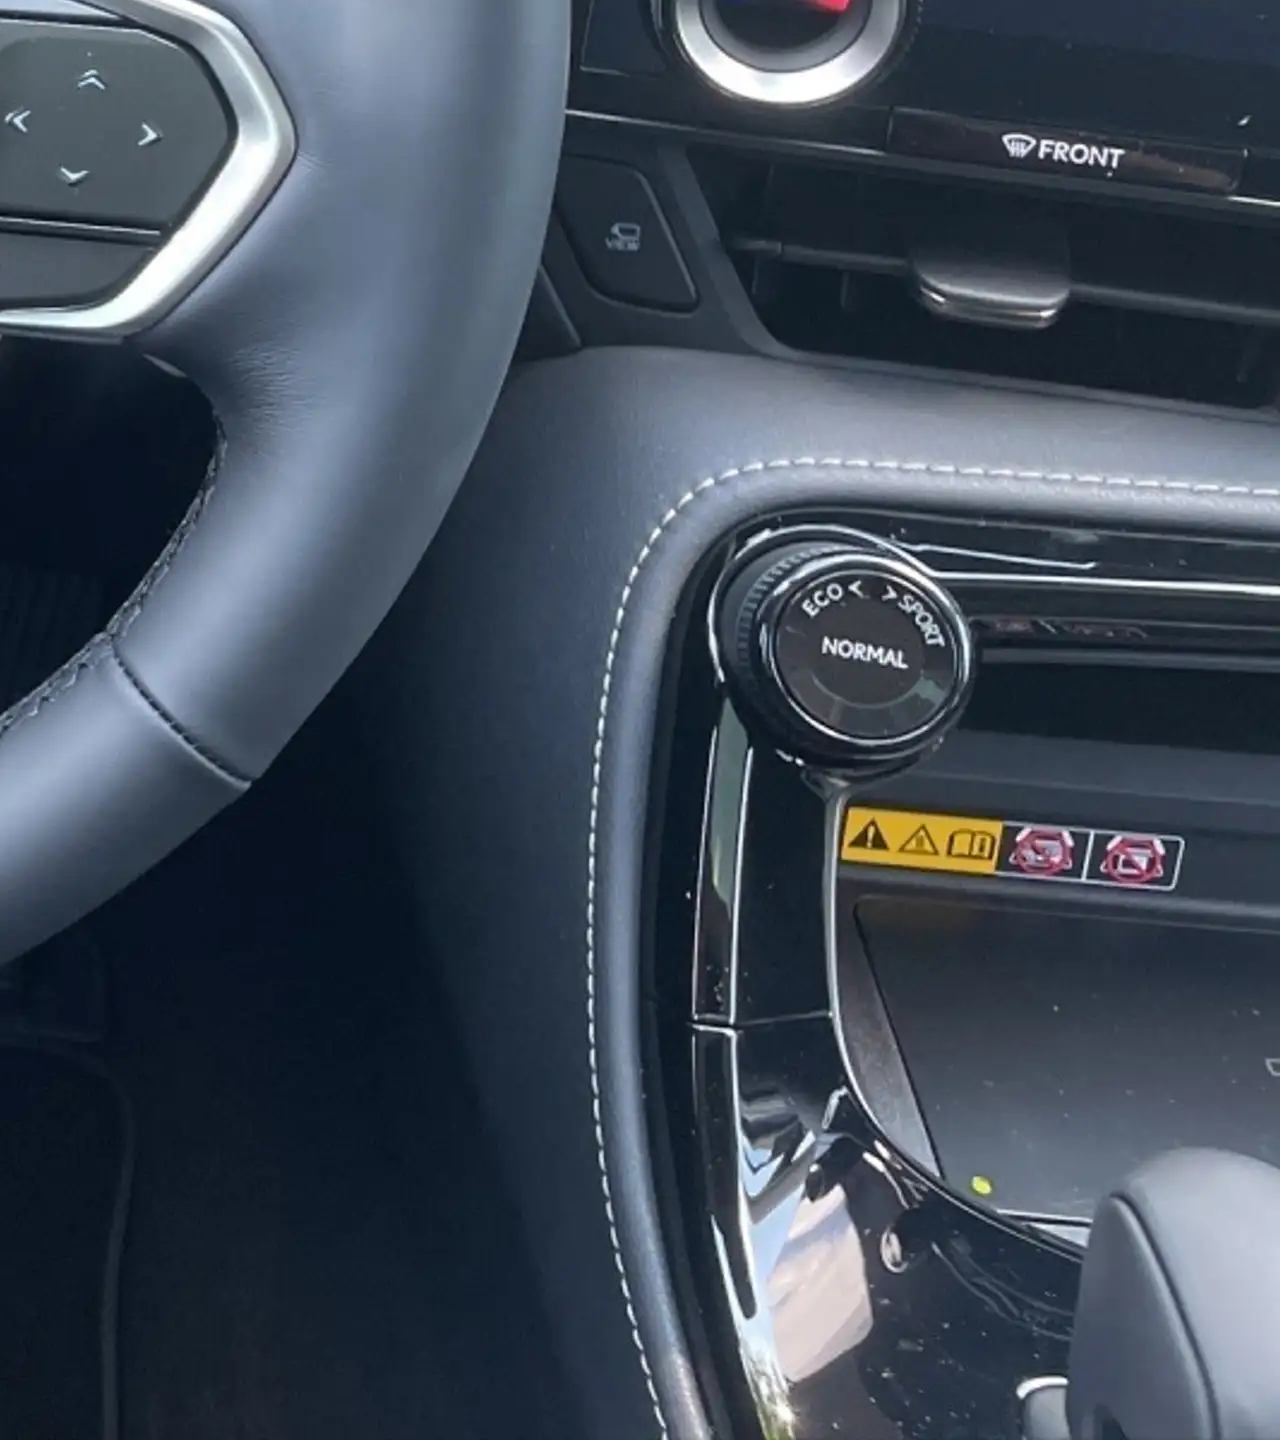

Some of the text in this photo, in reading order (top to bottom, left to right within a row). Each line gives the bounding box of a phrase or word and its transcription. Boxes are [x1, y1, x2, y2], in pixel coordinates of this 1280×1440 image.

[1037, 139, 1125, 168] FRONT
[800, 582, 845, 618] ECO
[897, 594, 946, 648] SPORT
[821, 635, 909, 670] NORMAL
